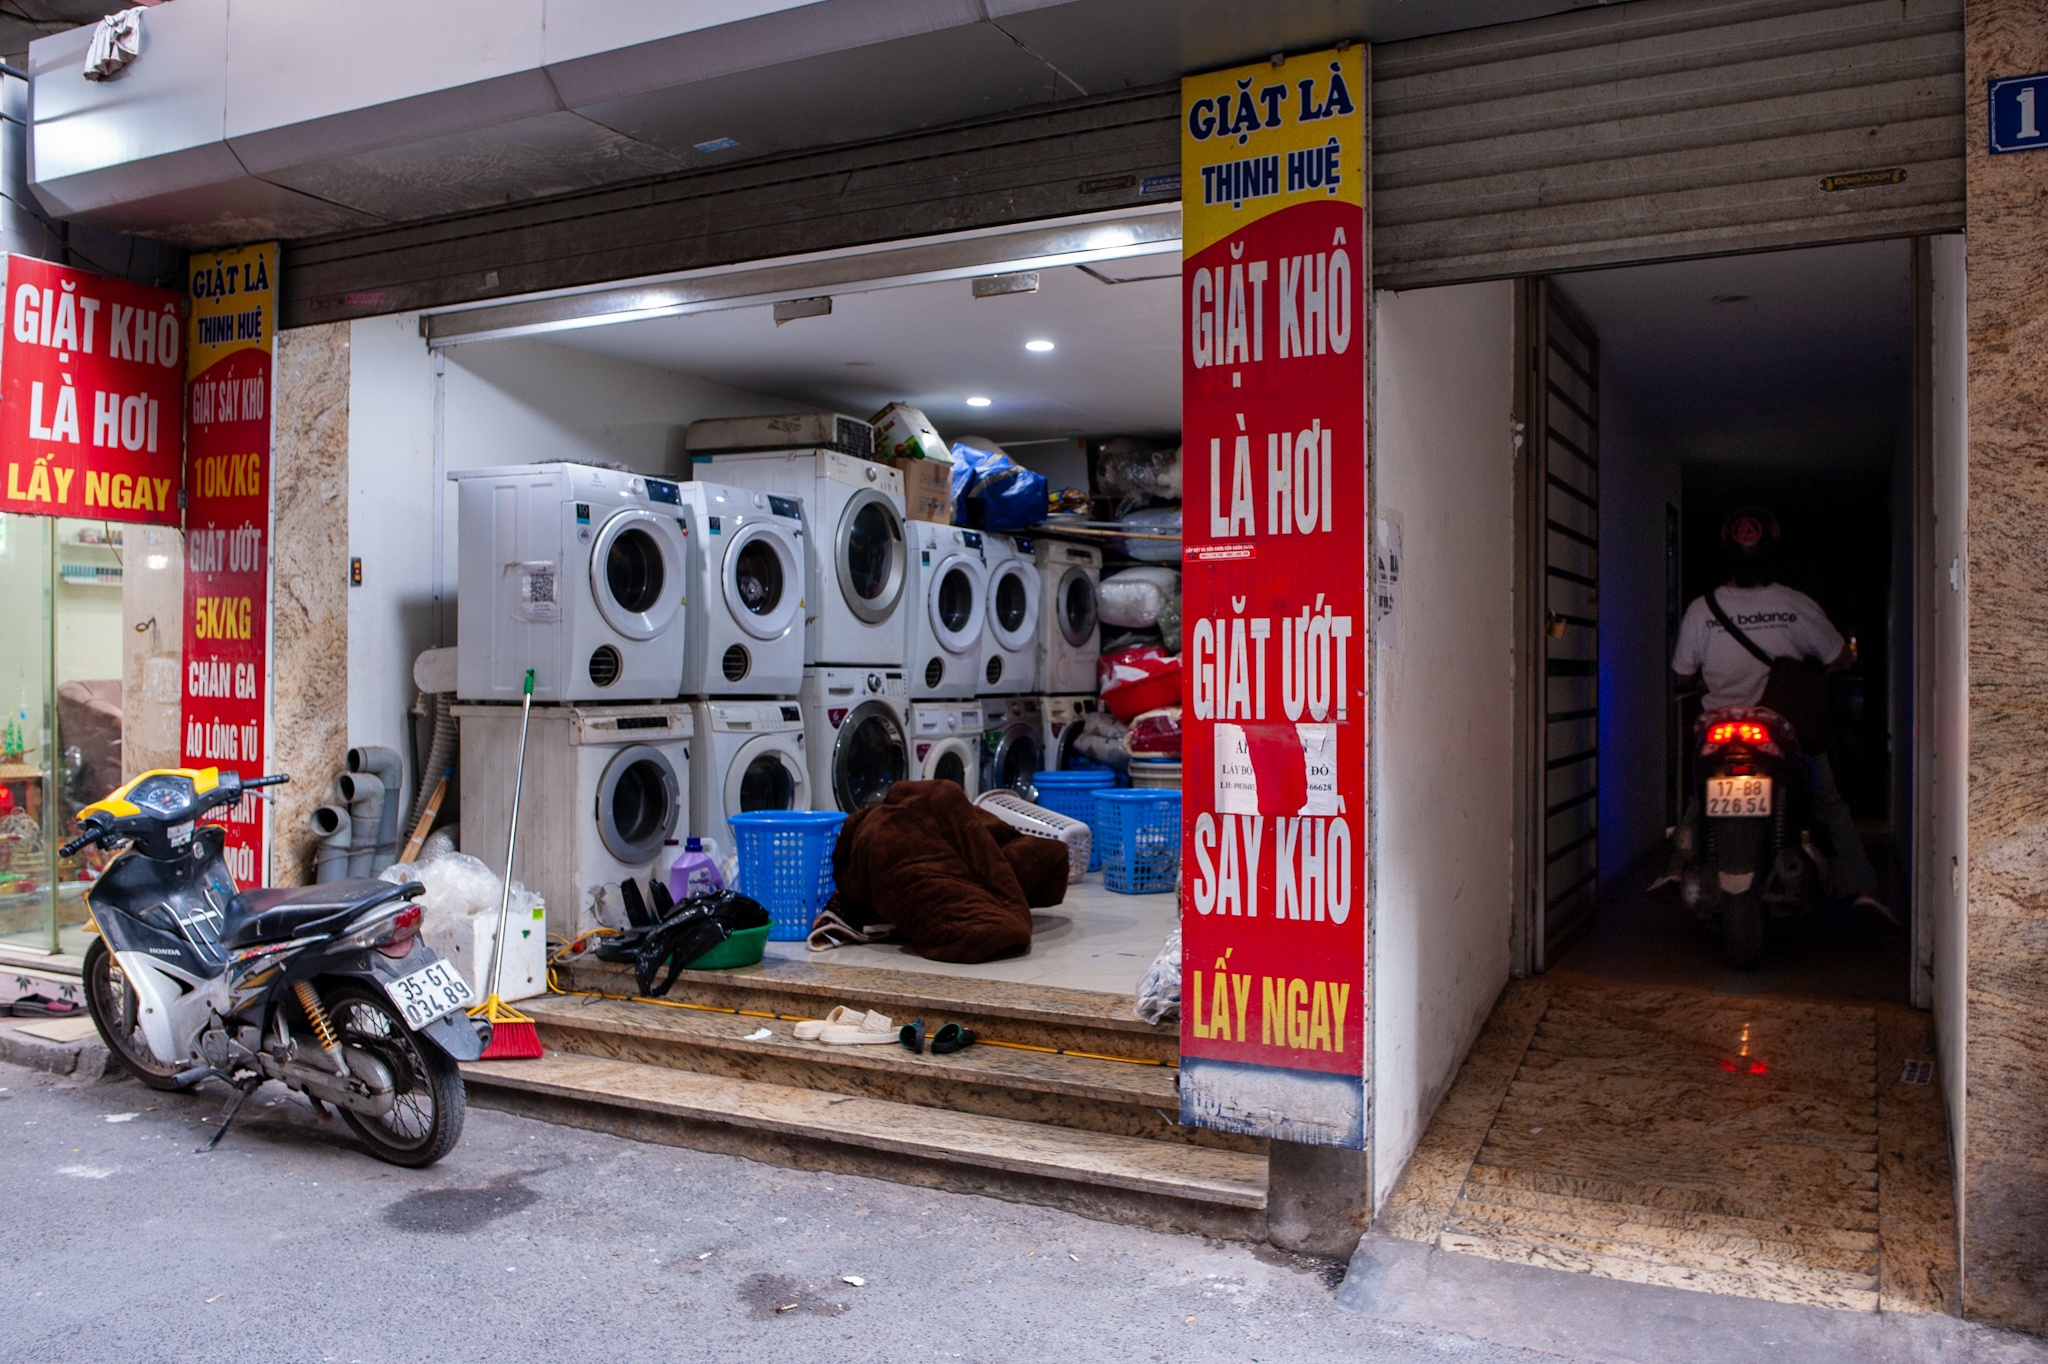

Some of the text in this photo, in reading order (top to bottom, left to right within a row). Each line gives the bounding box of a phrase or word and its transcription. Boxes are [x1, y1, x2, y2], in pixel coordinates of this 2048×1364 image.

[1189, 61, 1355, 145] GIẶT LÀ
[2016, 87, 2041, 139] 1
[1201, 136, 1342, 210] THỊNH HUỆ
[193, 253, 270, 305] GIẶT LÀ
[13, 279, 180, 368] GIẶT KHÔ
[197, 306, 262, 350] THỊNH HUỆ
[1191, 227, 1351, 388] GIẶT KHÔ
[29, 373, 159, 453] LÀ HƠI
[193, 363, 265, 434] GIẶT SẤY KHÔ
[7, 453, 171, 512] LẤY NGAY
[194, 453, 260, 498] 10K/KG
[1210, 413, 1332, 538] LÀ HƠI
[190, 519, 261, 582] GIẶT ƯỚT
[196, 597, 252, 641] 5K/KG
[1737, 611, 1797, 625] balance
[188, 654, 257, 700] CHĂN GA
[1282, 593, 1352, 722] ƯỚT
[186, 714, 258, 762] ÁO LÔNG VŨ
[1710, 797, 1767, 813] 226.54
[1717, 781, 1762, 796] 17-B8
[224, 841, 254, 882] MỚI
[1275, 794, 1352, 925] KHÔ
[149, 948, 182, 957] HONDA
[397, 963, 452, 1001] 35-G1
[405, 981, 470, 1025] 034.89
[1193, 947, 1351, 1053] LẤY NGAY
